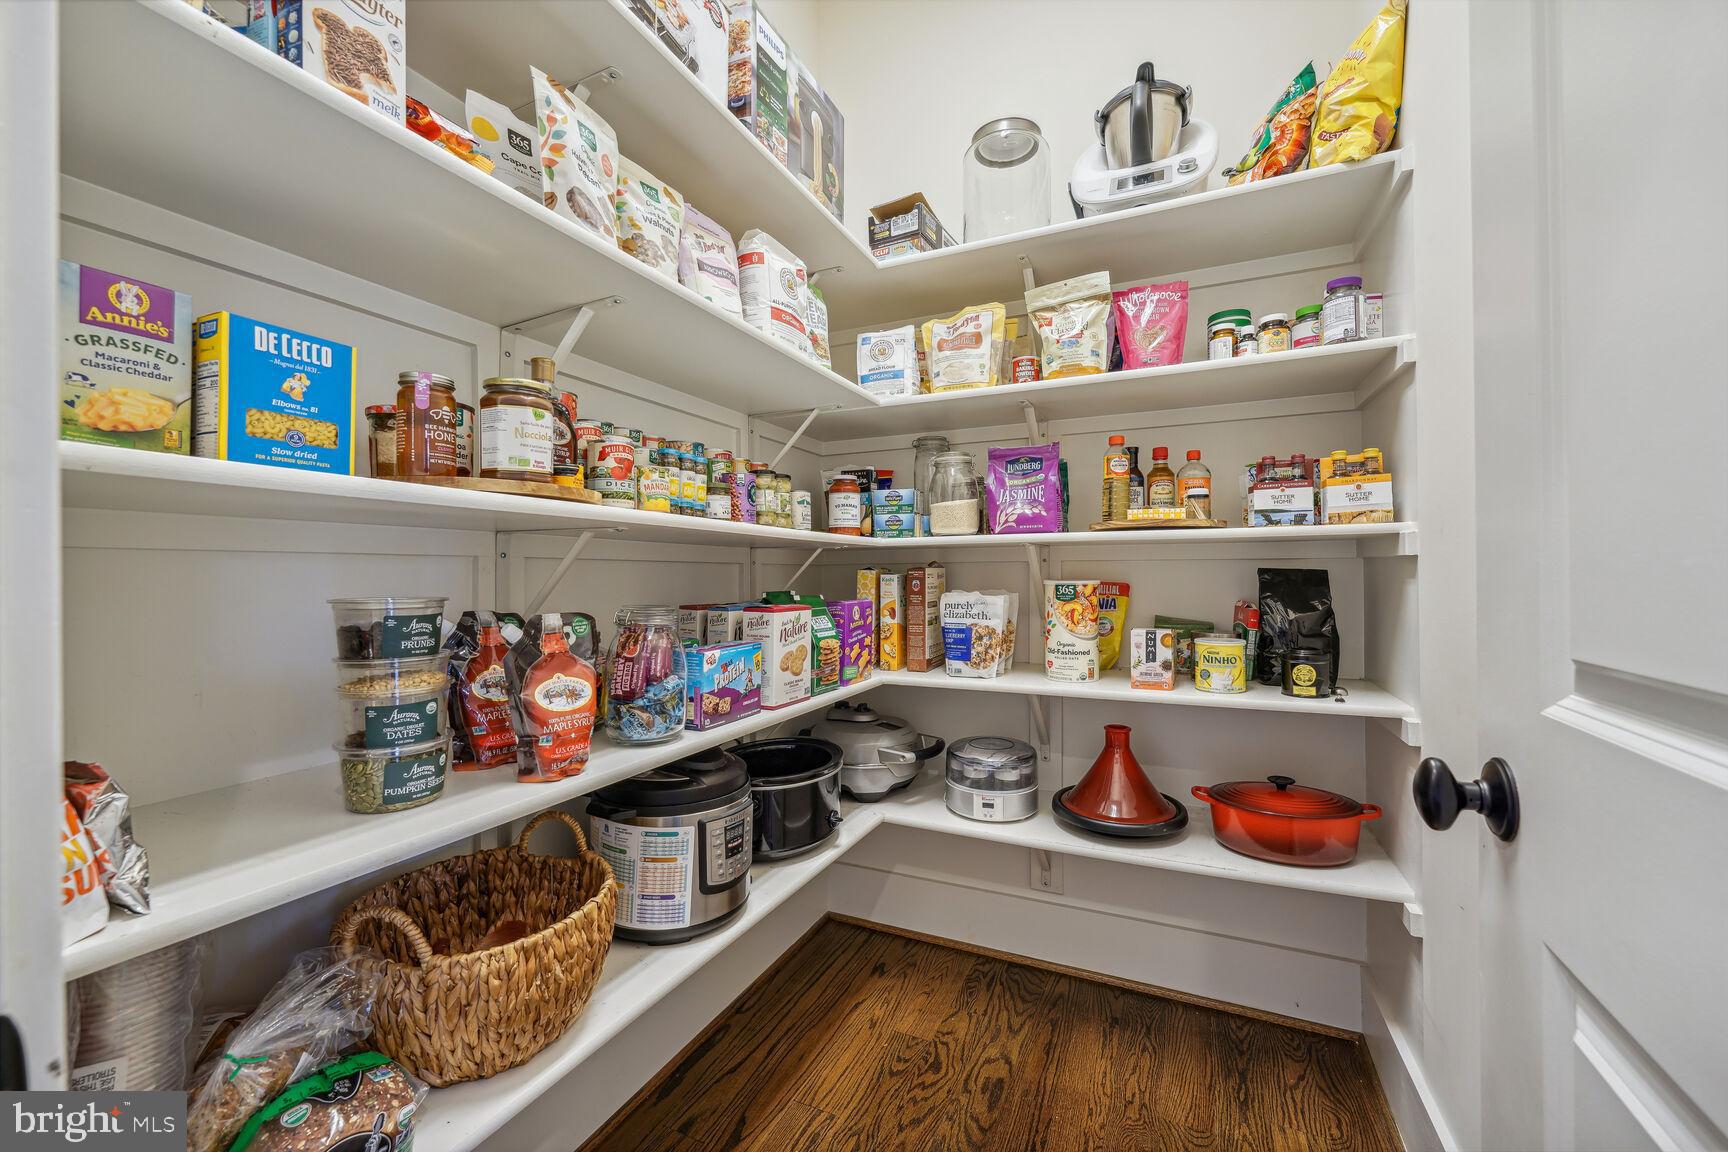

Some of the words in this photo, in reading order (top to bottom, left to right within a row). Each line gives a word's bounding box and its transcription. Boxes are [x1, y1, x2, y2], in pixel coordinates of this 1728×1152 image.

[759, 25, 784, 60] PHILIPS
[372, 95, 401, 121] melk
[509, 134, 530, 151] 365
[501, 152, 528, 170] Cape
[529, 165, 543, 177] Co
[641, 214, 675, 238] Walnuts
[85, 305, 171, 339] Annie's
[74, 333, 179, 366] GRASSFED
[254, 325, 278, 355] DE
[281, 333, 333, 368] CECCO
[94, 350, 150, 369] Macaroni
[152, 361, 161, 371] &
[80, 358, 123, 374] Classic
[125, 366, 173, 383] Cheddar
[271, 398, 301, 410] Elbows
[424, 429, 456, 443] HONE
[513, 425, 553, 443] Nocciola
[577, 428, 596, 436] MUIR
[271, 446, 294, 456] Slow
[294, 449, 318, 460] dried
[605, 446, 624, 454] MUIR
[1007, 461, 1041, 473] LUNDBERG
[605, 480, 632, 488] DICE
[996, 485, 1045, 505] JASMINE
[1056, 585, 1075, 595] 365
[944, 600, 976, 612] purely
[402, 618, 433, 633] Aurora
[746, 619, 770, 629] nature
[779, 620, 808, 643] nature
[401, 637, 435, 650] PRUNES
[1056, 640, 1076, 649] Organic
[1047, 648, 1091, 656] Old-Fashioned
[1202, 654, 1237, 665] NINHO
[714, 656, 746, 693] PROTEIN
[383, 708, 420, 724] Aurora
[392, 717, 417, 725] NATURAL
[476, 711, 505, 723] MAPLE
[382, 725, 406, 733] ORGANIC
[386, 727, 422, 741] DATES
[543, 722, 573, 734] MAPLE
[566, 743, 584, 753] GRADE
[403, 762, 435, 778] Aurora
[412, 770, 434, 779] NATURAL
[384, 782, 426, 797] PUMPKIN
[406, 779, 427, 787] ORGANIC
